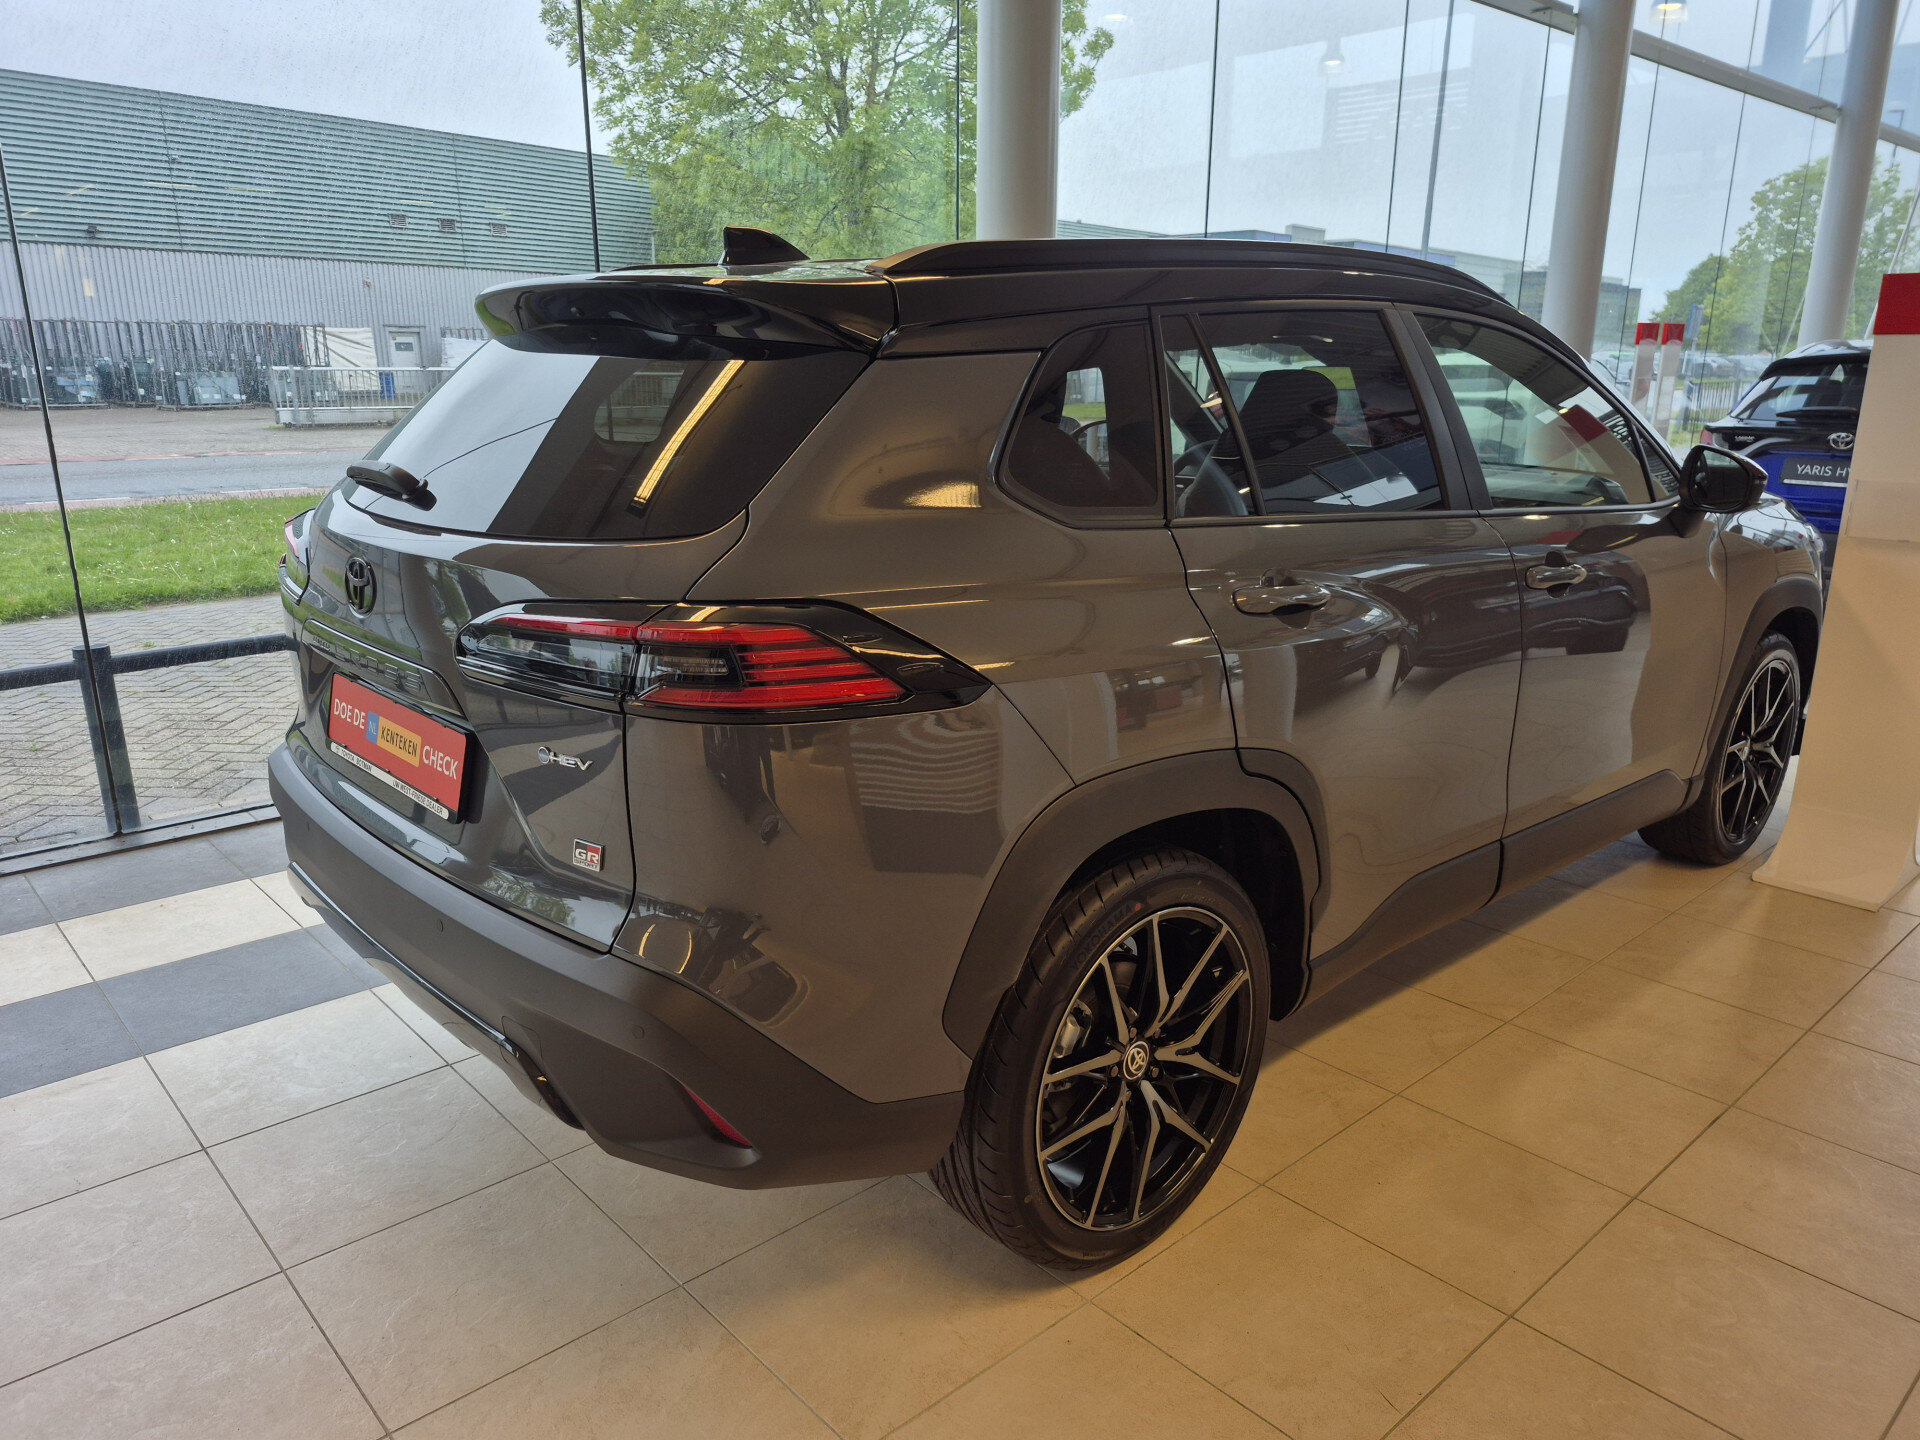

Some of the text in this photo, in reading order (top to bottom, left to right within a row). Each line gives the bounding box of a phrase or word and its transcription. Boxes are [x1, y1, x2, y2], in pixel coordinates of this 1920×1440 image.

[1797, 464, 1832, 477] YARIS
[333, 698, 458, 780] DOE DE NL KENTEKEN CHECK
[341, 749, 355, 762] TOYOTA
[426, 798, 443, 815] DEALER
[575, 848, 599, 864] GR
